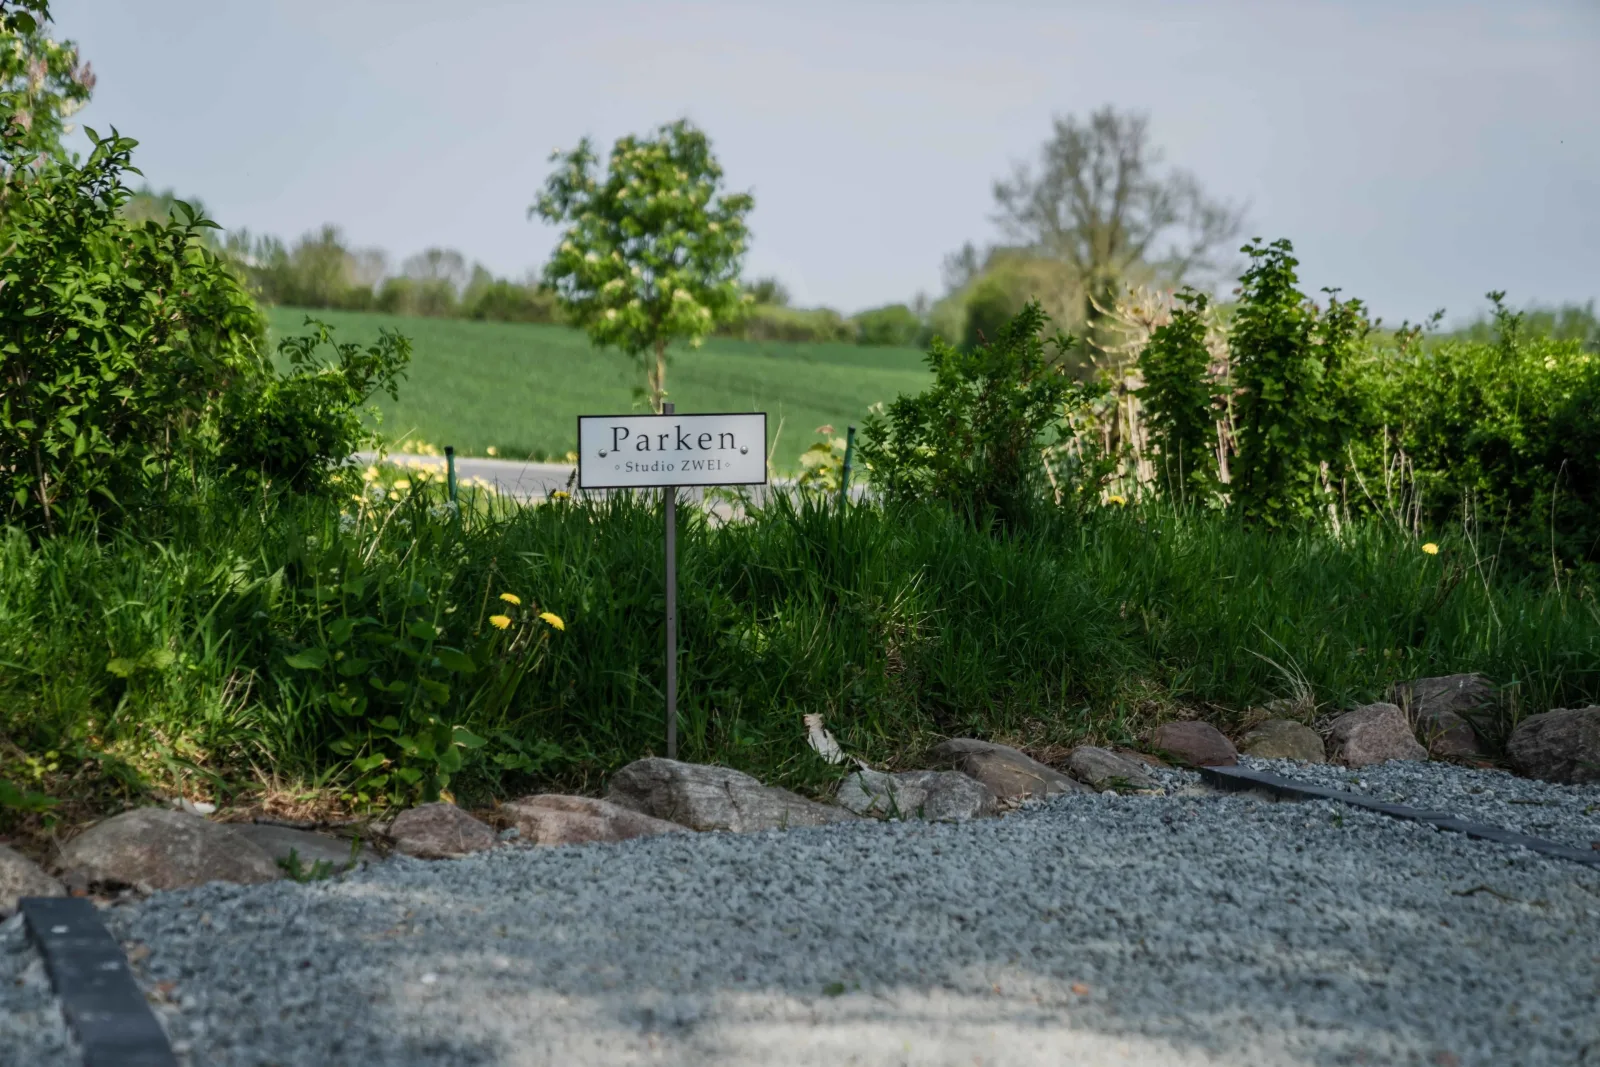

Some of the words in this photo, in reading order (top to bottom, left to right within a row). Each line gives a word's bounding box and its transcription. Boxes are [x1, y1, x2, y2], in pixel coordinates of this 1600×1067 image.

[610, 425, 737, 452] Parken
[625, 460, 675, 472] Studio
[681, 459, 722, 471] ZWEI
